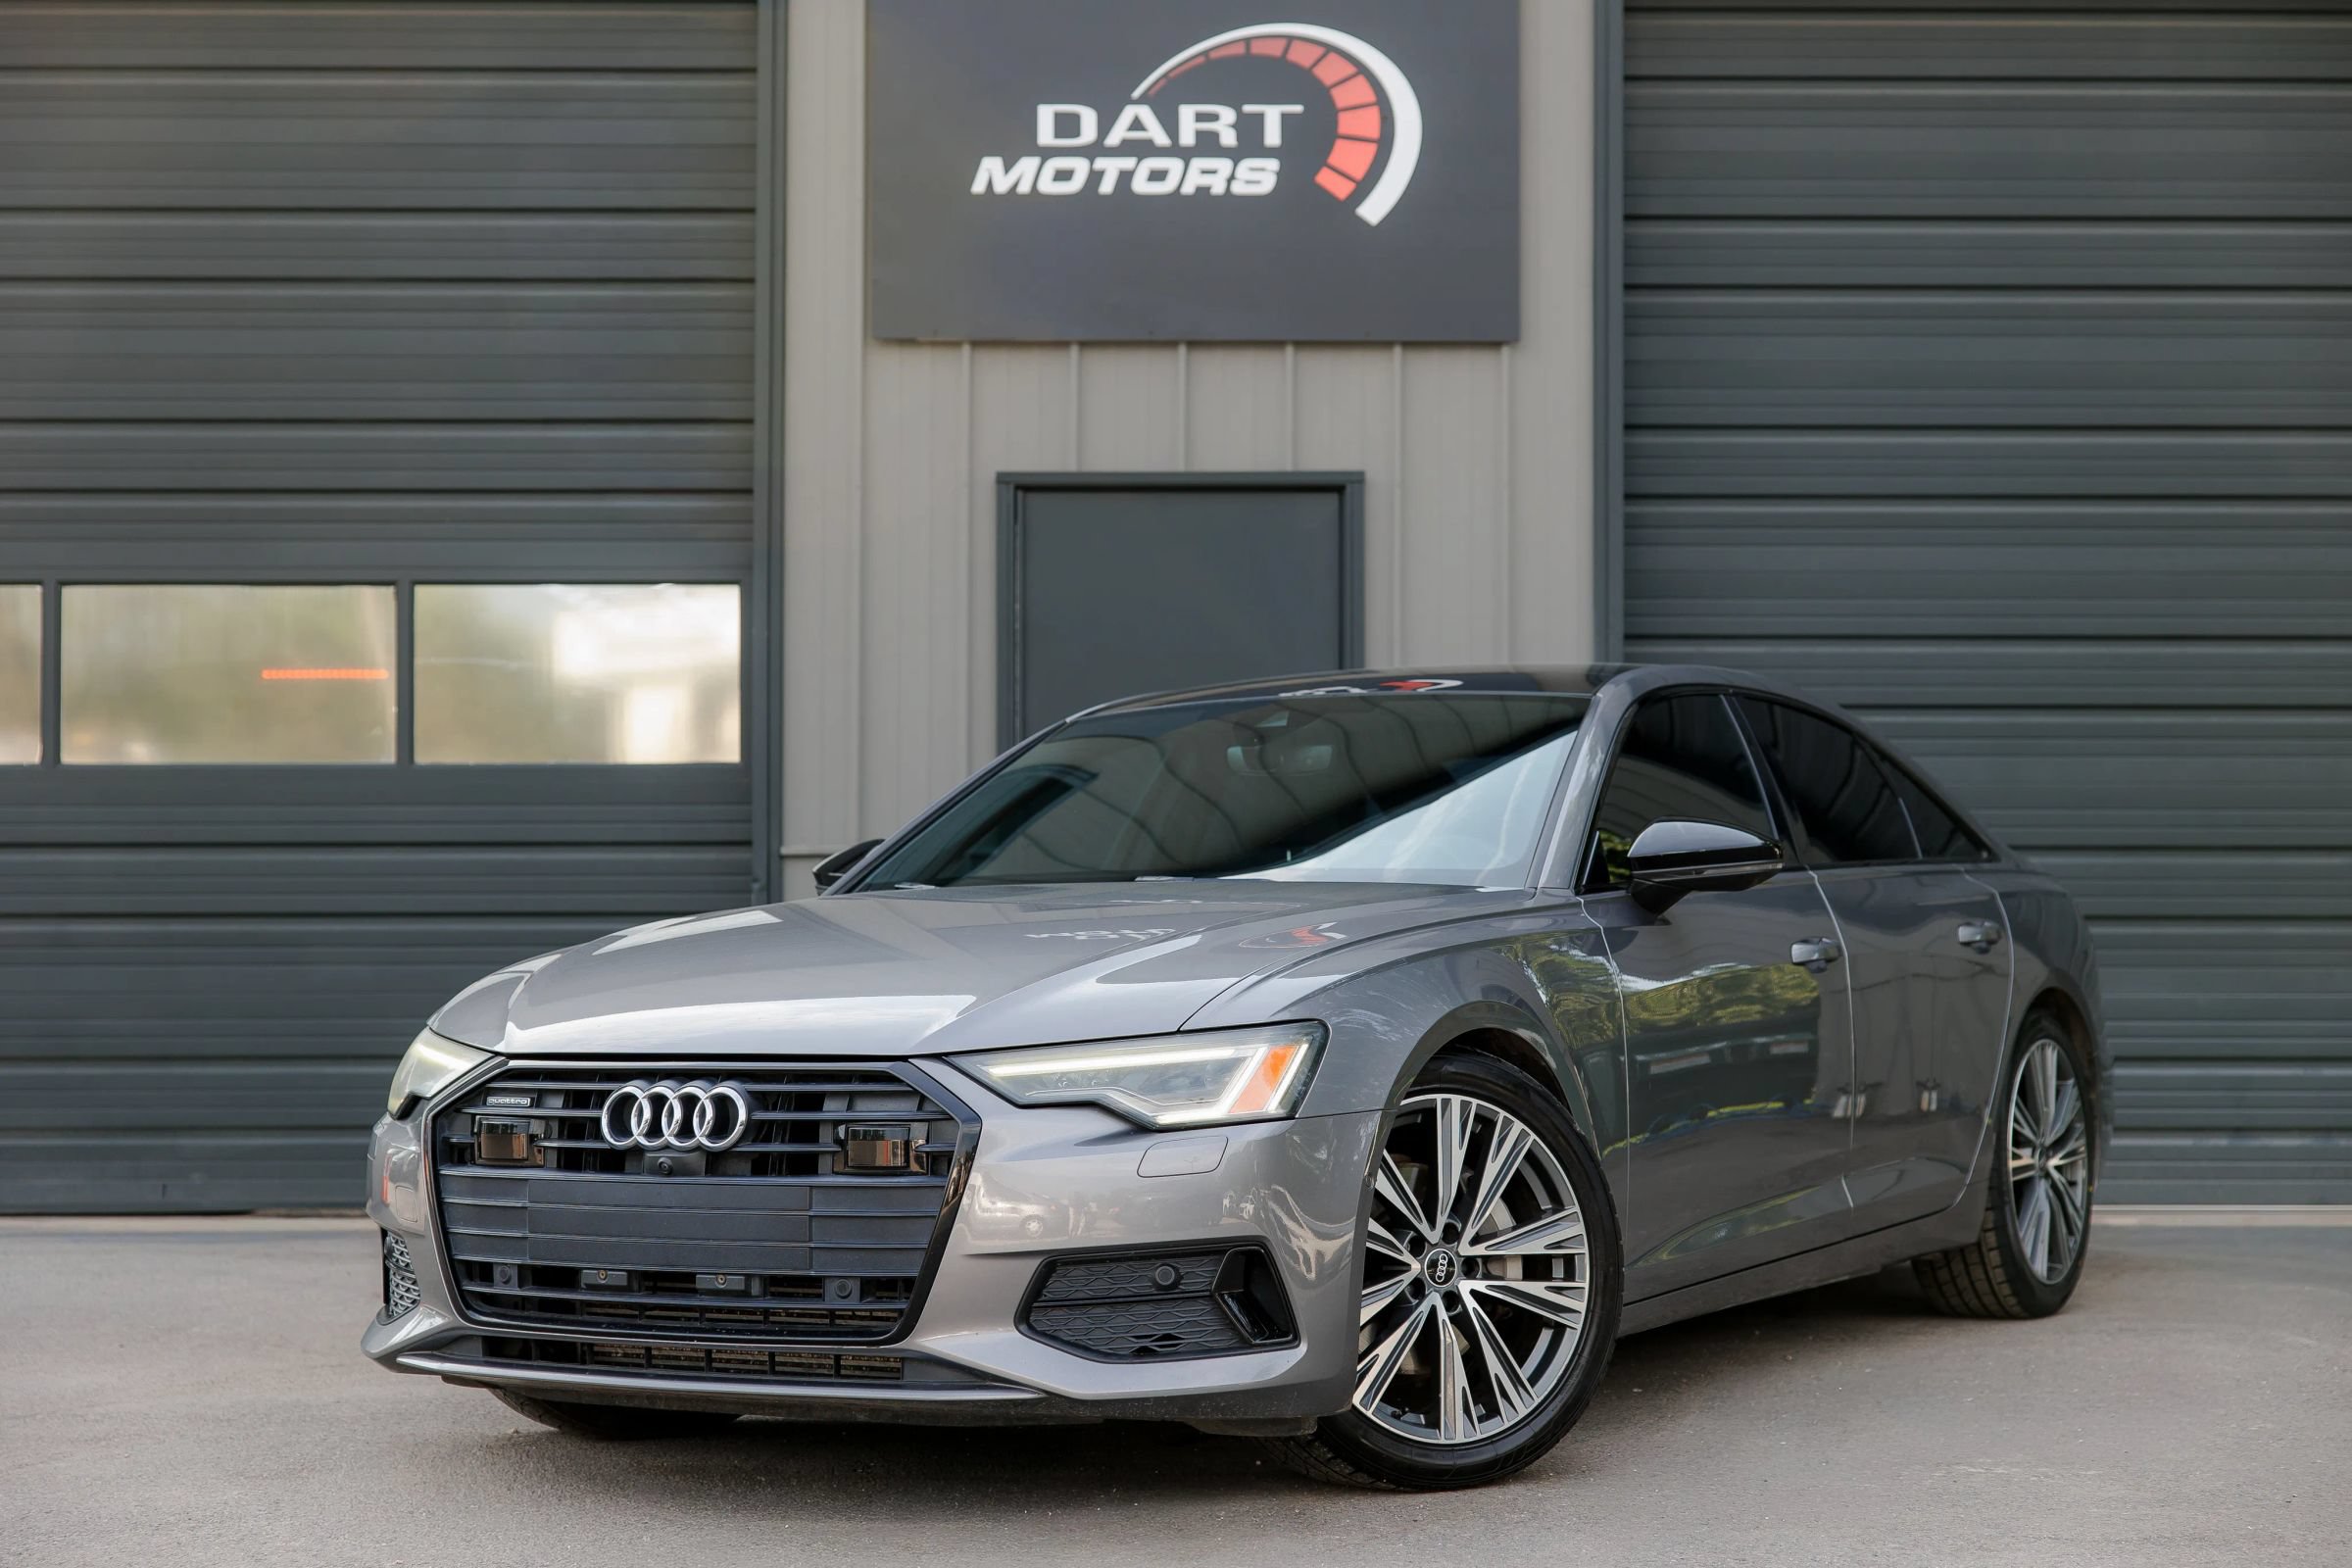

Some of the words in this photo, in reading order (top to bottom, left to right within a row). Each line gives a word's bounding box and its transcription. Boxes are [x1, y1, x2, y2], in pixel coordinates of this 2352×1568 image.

[1036, 103, 1304, 148] DART
[970, 156, 1281, 196] MOTORS
[488, 1098, 527, 1106] quattro
